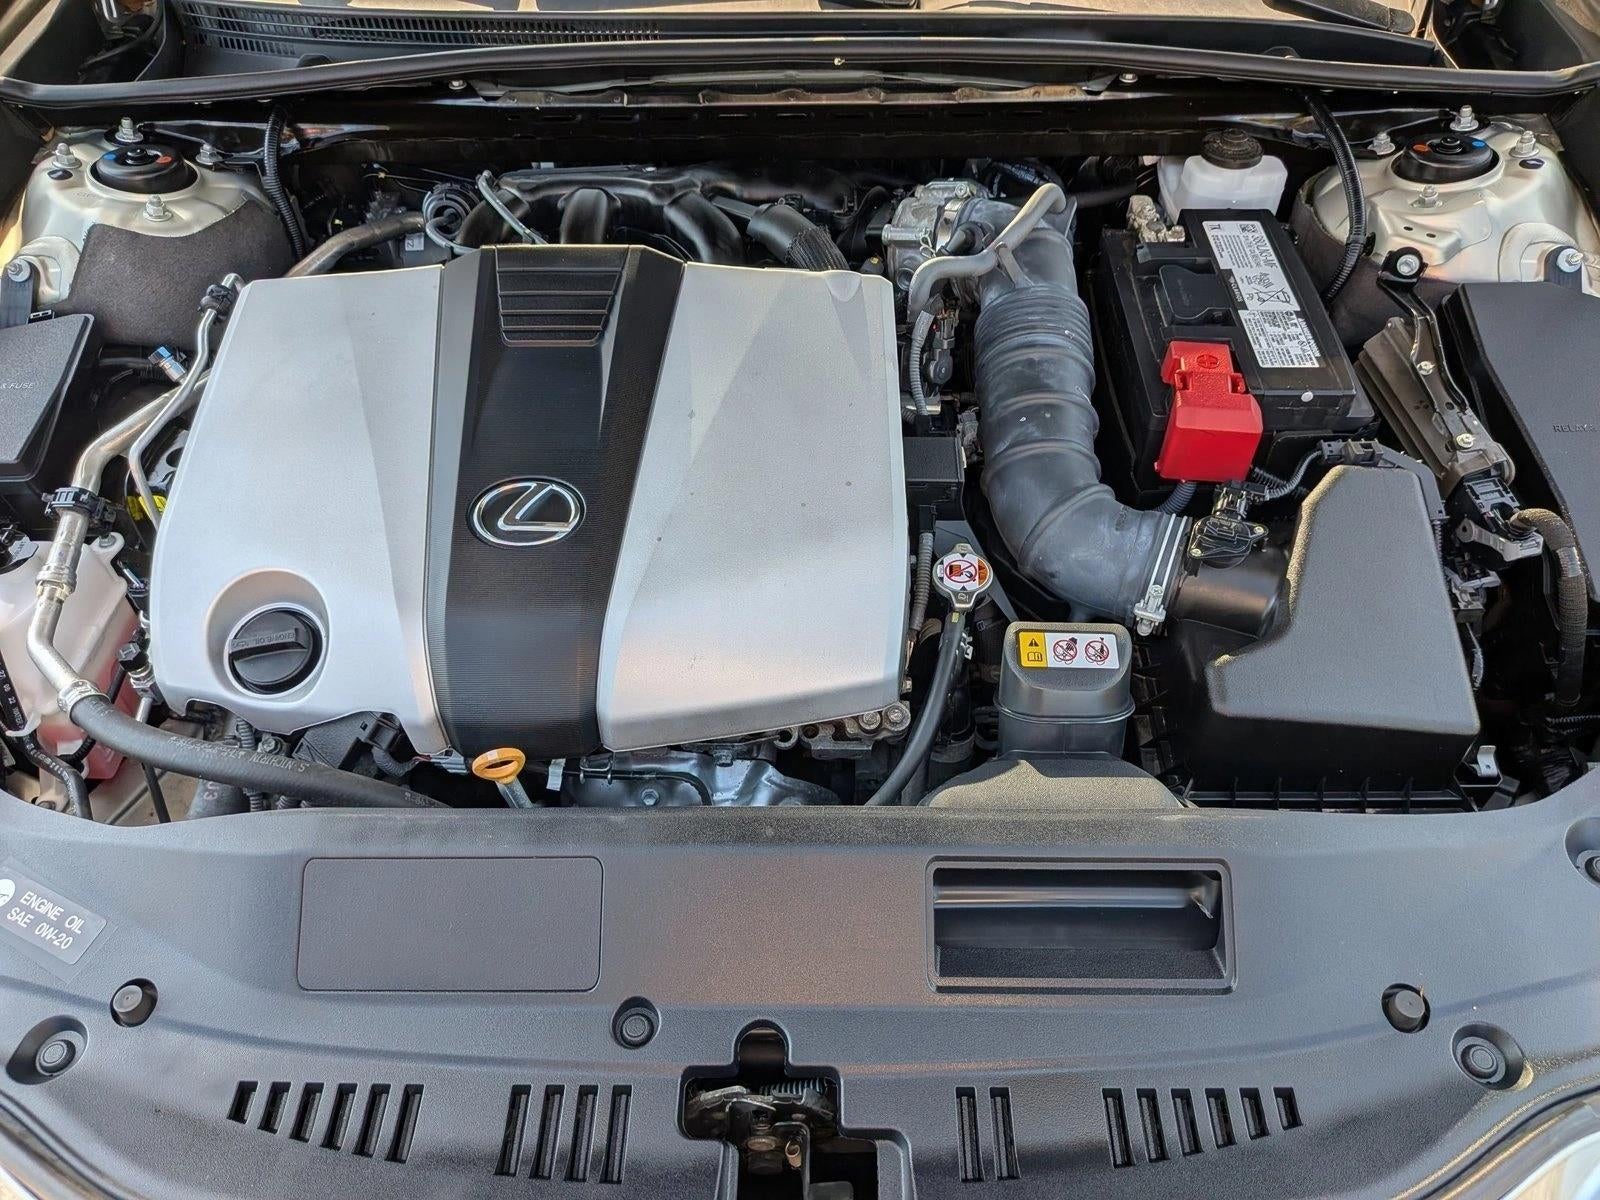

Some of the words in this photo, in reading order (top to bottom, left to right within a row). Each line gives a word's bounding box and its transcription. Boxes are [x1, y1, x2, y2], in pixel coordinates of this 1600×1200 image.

[6, 907, 34, 928] SAE
[34, 922, 73, 950] 0W-20
[20, 890, 64, 921] ENGINE
[64, 915, 85, 934] OIL
